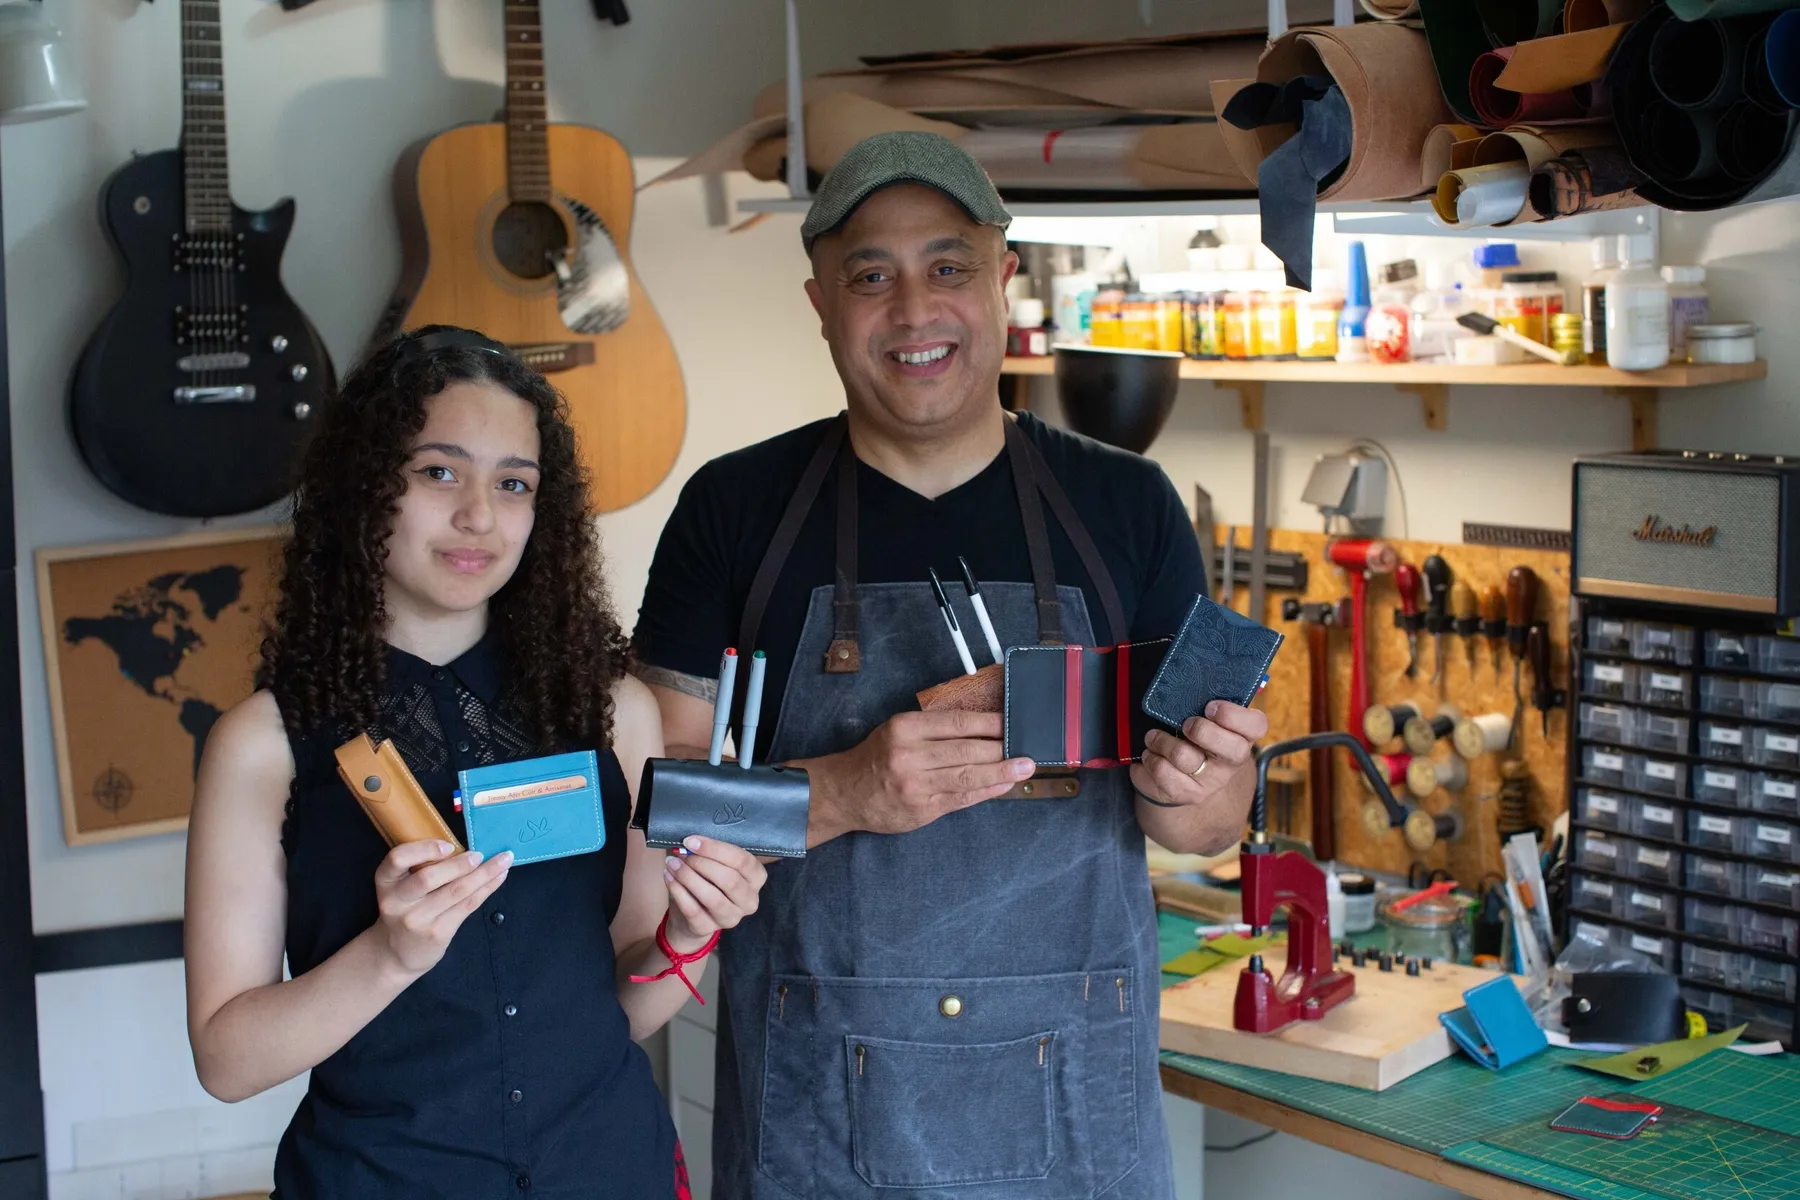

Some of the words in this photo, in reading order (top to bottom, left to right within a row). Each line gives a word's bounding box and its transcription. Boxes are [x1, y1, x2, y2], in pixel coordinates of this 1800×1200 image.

[1629, 514, 1718, 547] Marshall
[521, 788, 536, 797] Cuir
[544, 783, 572, 793] Artisanat
